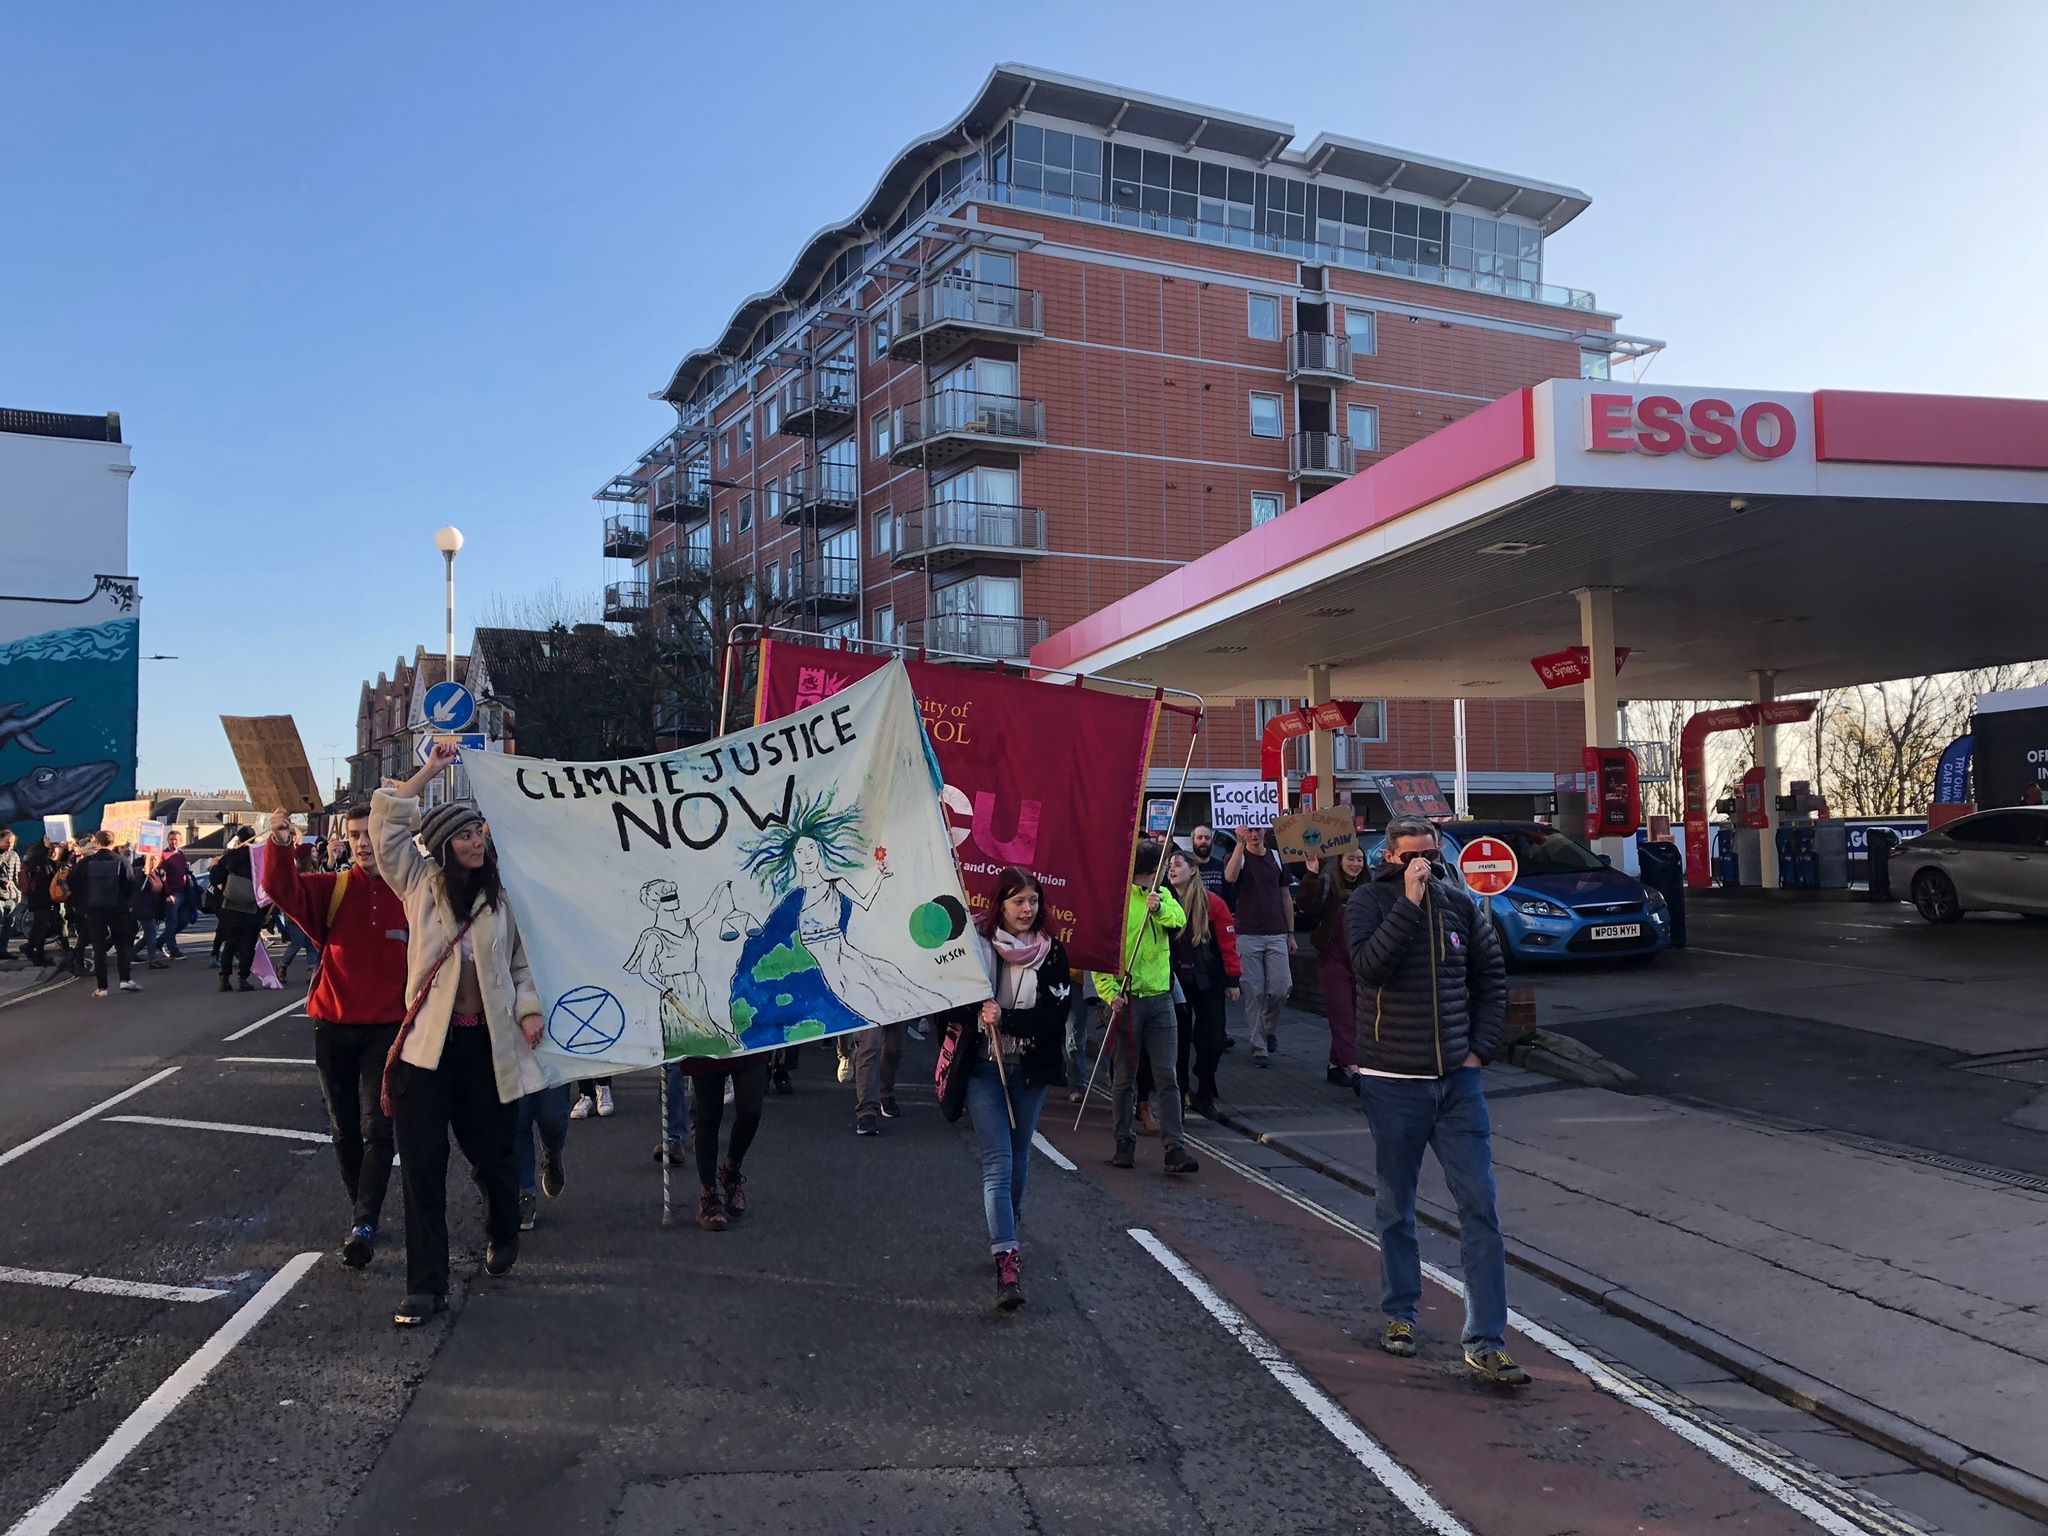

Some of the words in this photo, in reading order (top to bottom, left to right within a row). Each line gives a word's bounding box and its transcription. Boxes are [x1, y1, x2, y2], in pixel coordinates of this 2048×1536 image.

[1586, 393, 1797, 460] ESSO
[1552, 664, 1581, 678] Synerg
[951, 702, 972, 718] of
[516, 761, 684, 799] CLIMATE
[700, 705, 856, 783] JUSTICE
[1943, 763, 1953, 784] CAR
[1954, 756, 1965, 776] TRY
[1212, 783, 1278, 804] Ecocide
[1952, 777, 1963, 799] OUR
[611, 775, 796, 852] NOW
[1214, 807, 1277, 826] Homicide
[1320, 833, 1352, 854] AGAIN
[963, 861, 985, 874] and
[1595, 927, 1618, 937] WP09
[1620, 926, 1637, 935] MYH
